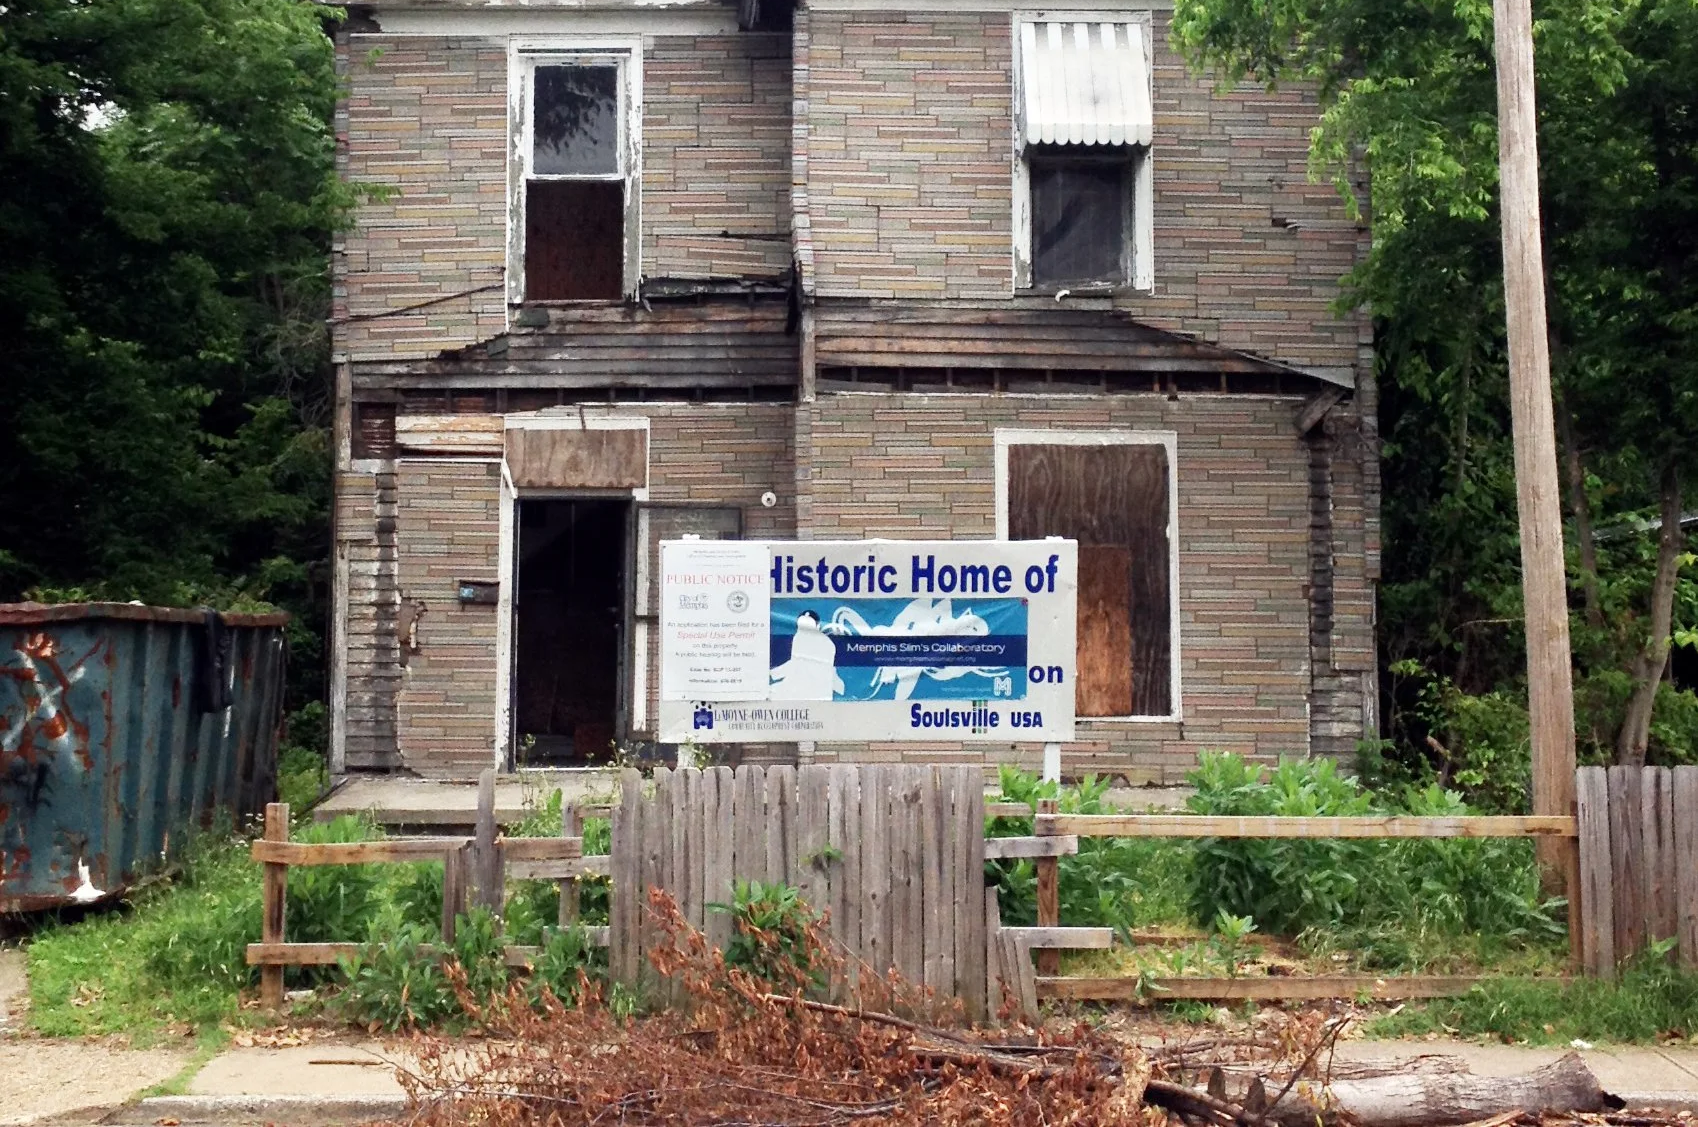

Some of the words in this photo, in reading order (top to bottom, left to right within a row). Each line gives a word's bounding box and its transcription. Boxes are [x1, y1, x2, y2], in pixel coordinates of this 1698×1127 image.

[666, 574, 713, 585] PUBLIC
[717, 574, 764, 585] NOTICE
[770, 555, 897, 593] Historic
[912, 555, 1011, 593] Home
[1025, 555, 1059, 593] of
[677, 631, 708, 640] Special
[709, 631, 726, 639] Use
[728, 631, 756, 639] Permit
[846, 643, 898, 654] Memphis
[899, 643, 930, 652] Slim's
[931, 643, 1006, 654] Collaboratory
[1028, 665, 1064, 684] on
[775, 708, 810, 721] COLLEGE
[910, 703, 1000, 727] Soulsville
[1010, 711, 1043, 727] USA
